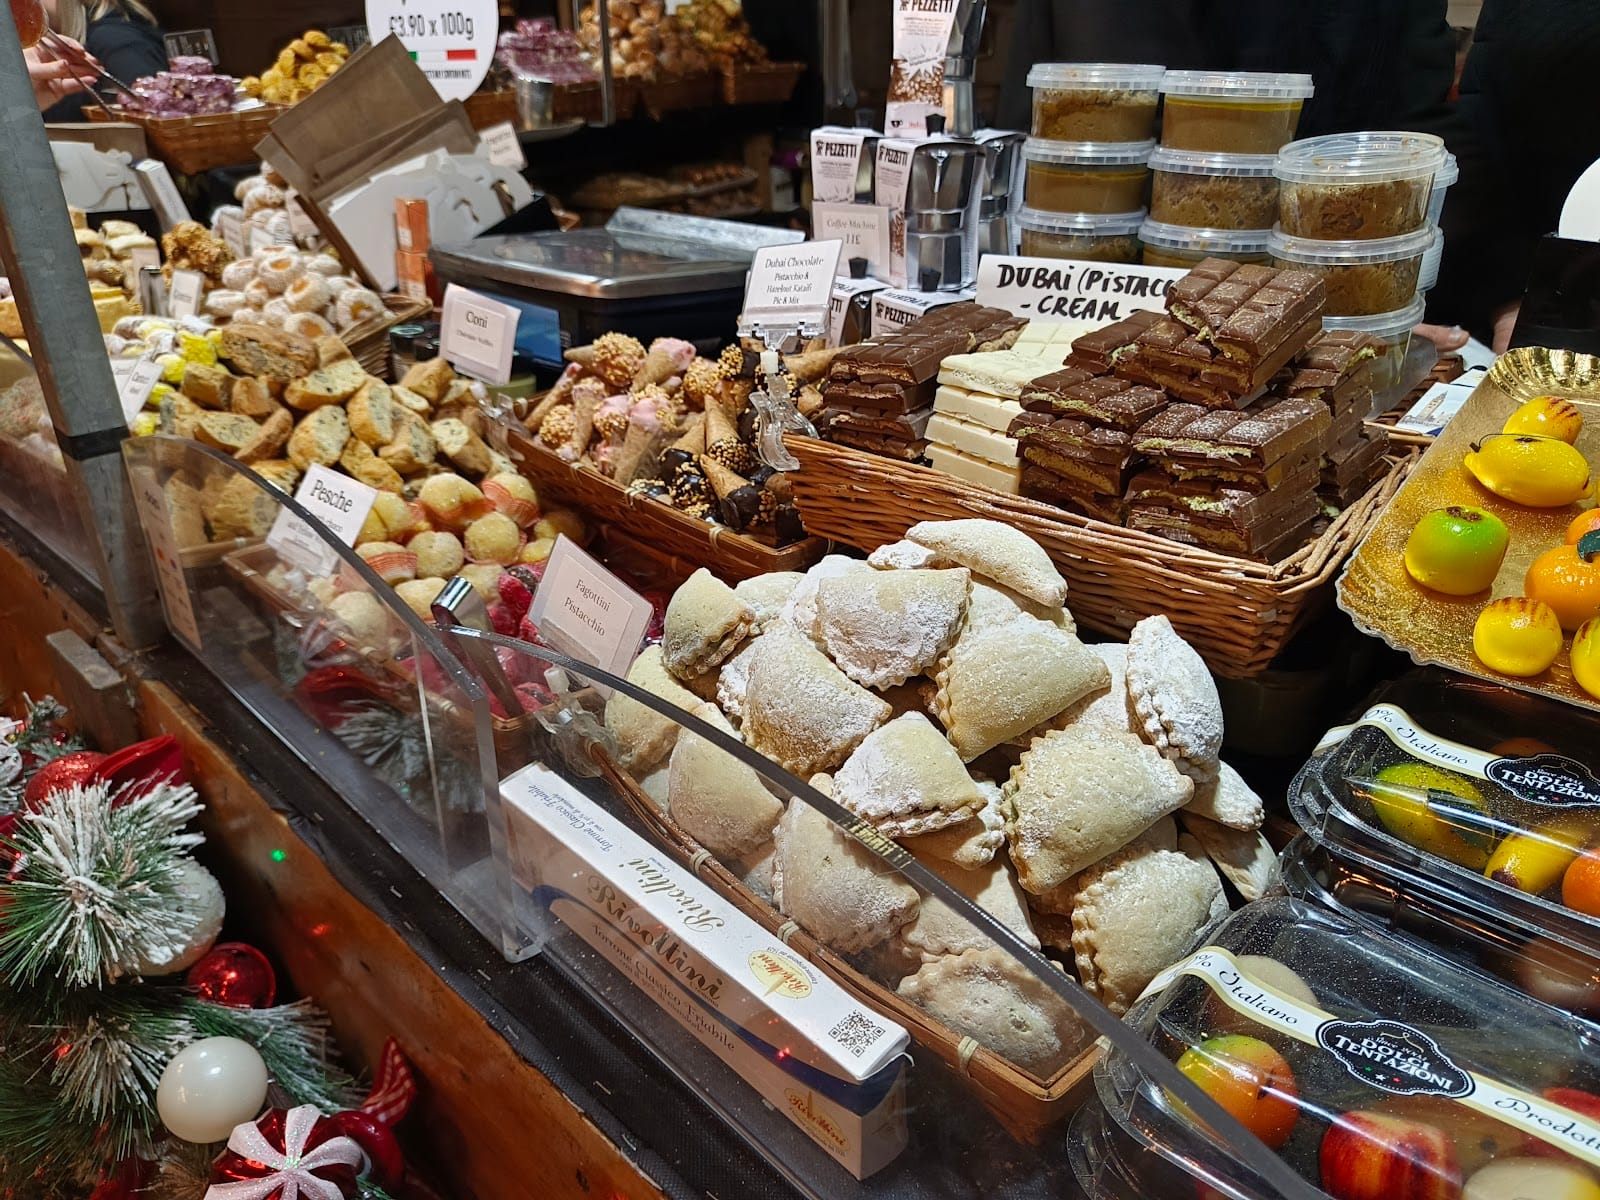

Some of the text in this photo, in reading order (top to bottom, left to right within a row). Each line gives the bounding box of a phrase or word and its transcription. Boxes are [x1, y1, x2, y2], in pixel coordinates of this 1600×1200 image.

[912, 0, 953, 13] PEZZETTI
[429, 20, 438, 36] x
[441, 12, 473, 40] 100g
[825, 142, 857, 158] PEZZETTI
[885, 148, 908, 166] PEZZETTI
[827, 219, 877, 231] Coffee Machine
[765, 256, 824, 269] Dubai Chocolate
[774, 272, 809, 281] Pistacchio &
[782, 296, 787, 304] &
[788, 296, 800, 304] Mix
[1038, 296, 1121, 321] CREAM
[466, 311, 488, 328] Coni
[309, 479, 353, 513] Pesche
[575, 579, 611, 612] Fagottini
[564, 597, 605, 636] Pistacchio
[1396, 726, 1469, 765] Italiano
[1524, 770, 1585, 792] DOLCI
[528, 784, 613, 852] Torrone Classico Friabile
[620, 857, 725, 933] Rivoltini
[587, 874, 725, 1000] Rivoltini
[593, 924, 735, 1051] Torrone Classico Friabile
[753, 953, 809, 993] Rivoltini
[1219, 970, 1298, 1025] Italiano
[1335, 1034, 1453, 1090] TENTAZIONI
[1361, 1038, 1430, 1070] DOLCI
